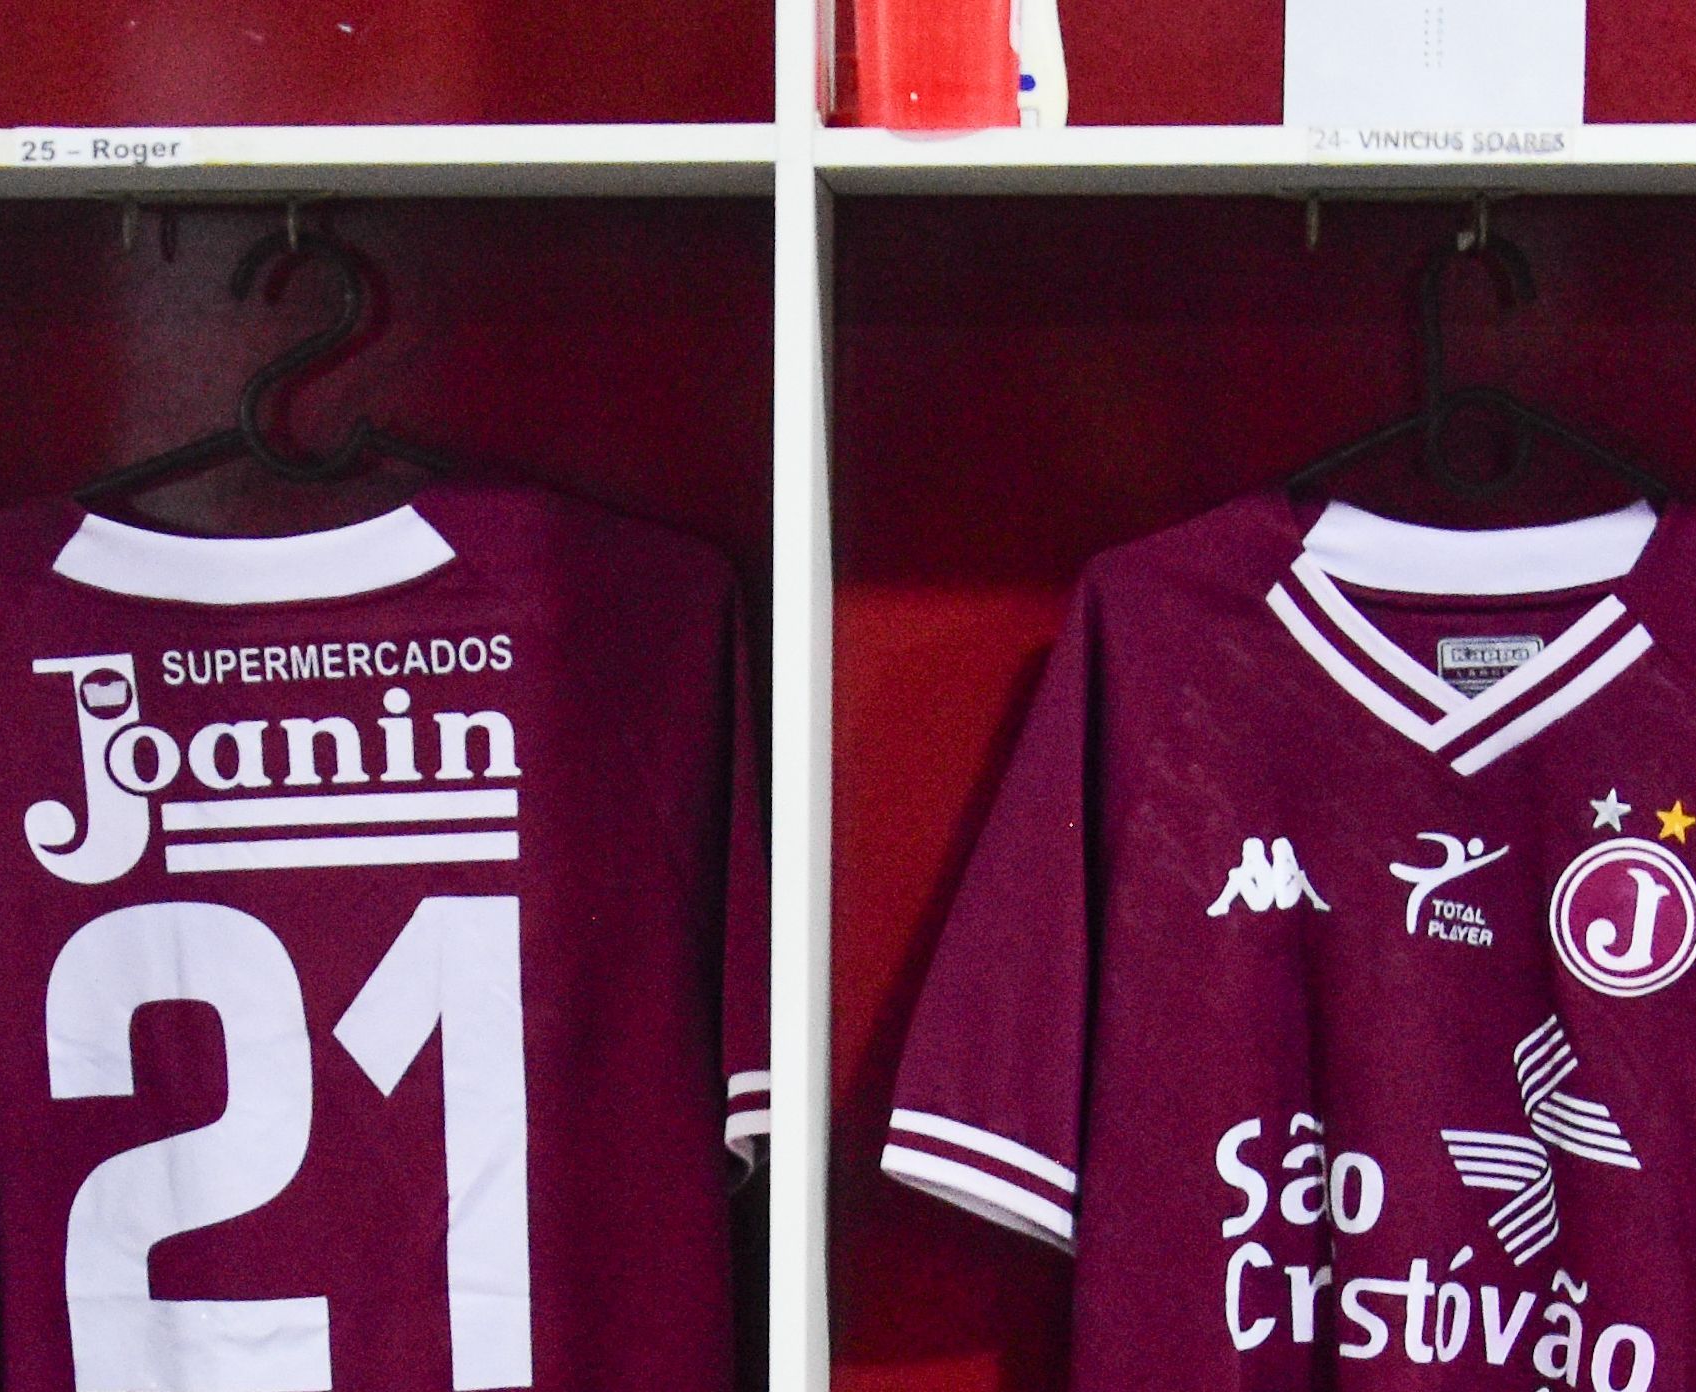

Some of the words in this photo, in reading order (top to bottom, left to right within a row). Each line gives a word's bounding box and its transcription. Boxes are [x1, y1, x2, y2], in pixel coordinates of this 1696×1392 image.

[21, 140, 56, 162] 25
[92, 138, 182, 165] Roger
[1358, 131, 1463, 152] VINICIUS
[1471, 132, 1565, 153] SOARES
[162, 634, 513, 686] SUPERMERCADOS
[24, 653, 522, 885] Joanin
[1431, 899, 1487, 926] TOTAL
[1585, 867, 1671, 972] J
[1427, 921, 1493, 947] PLAYER
